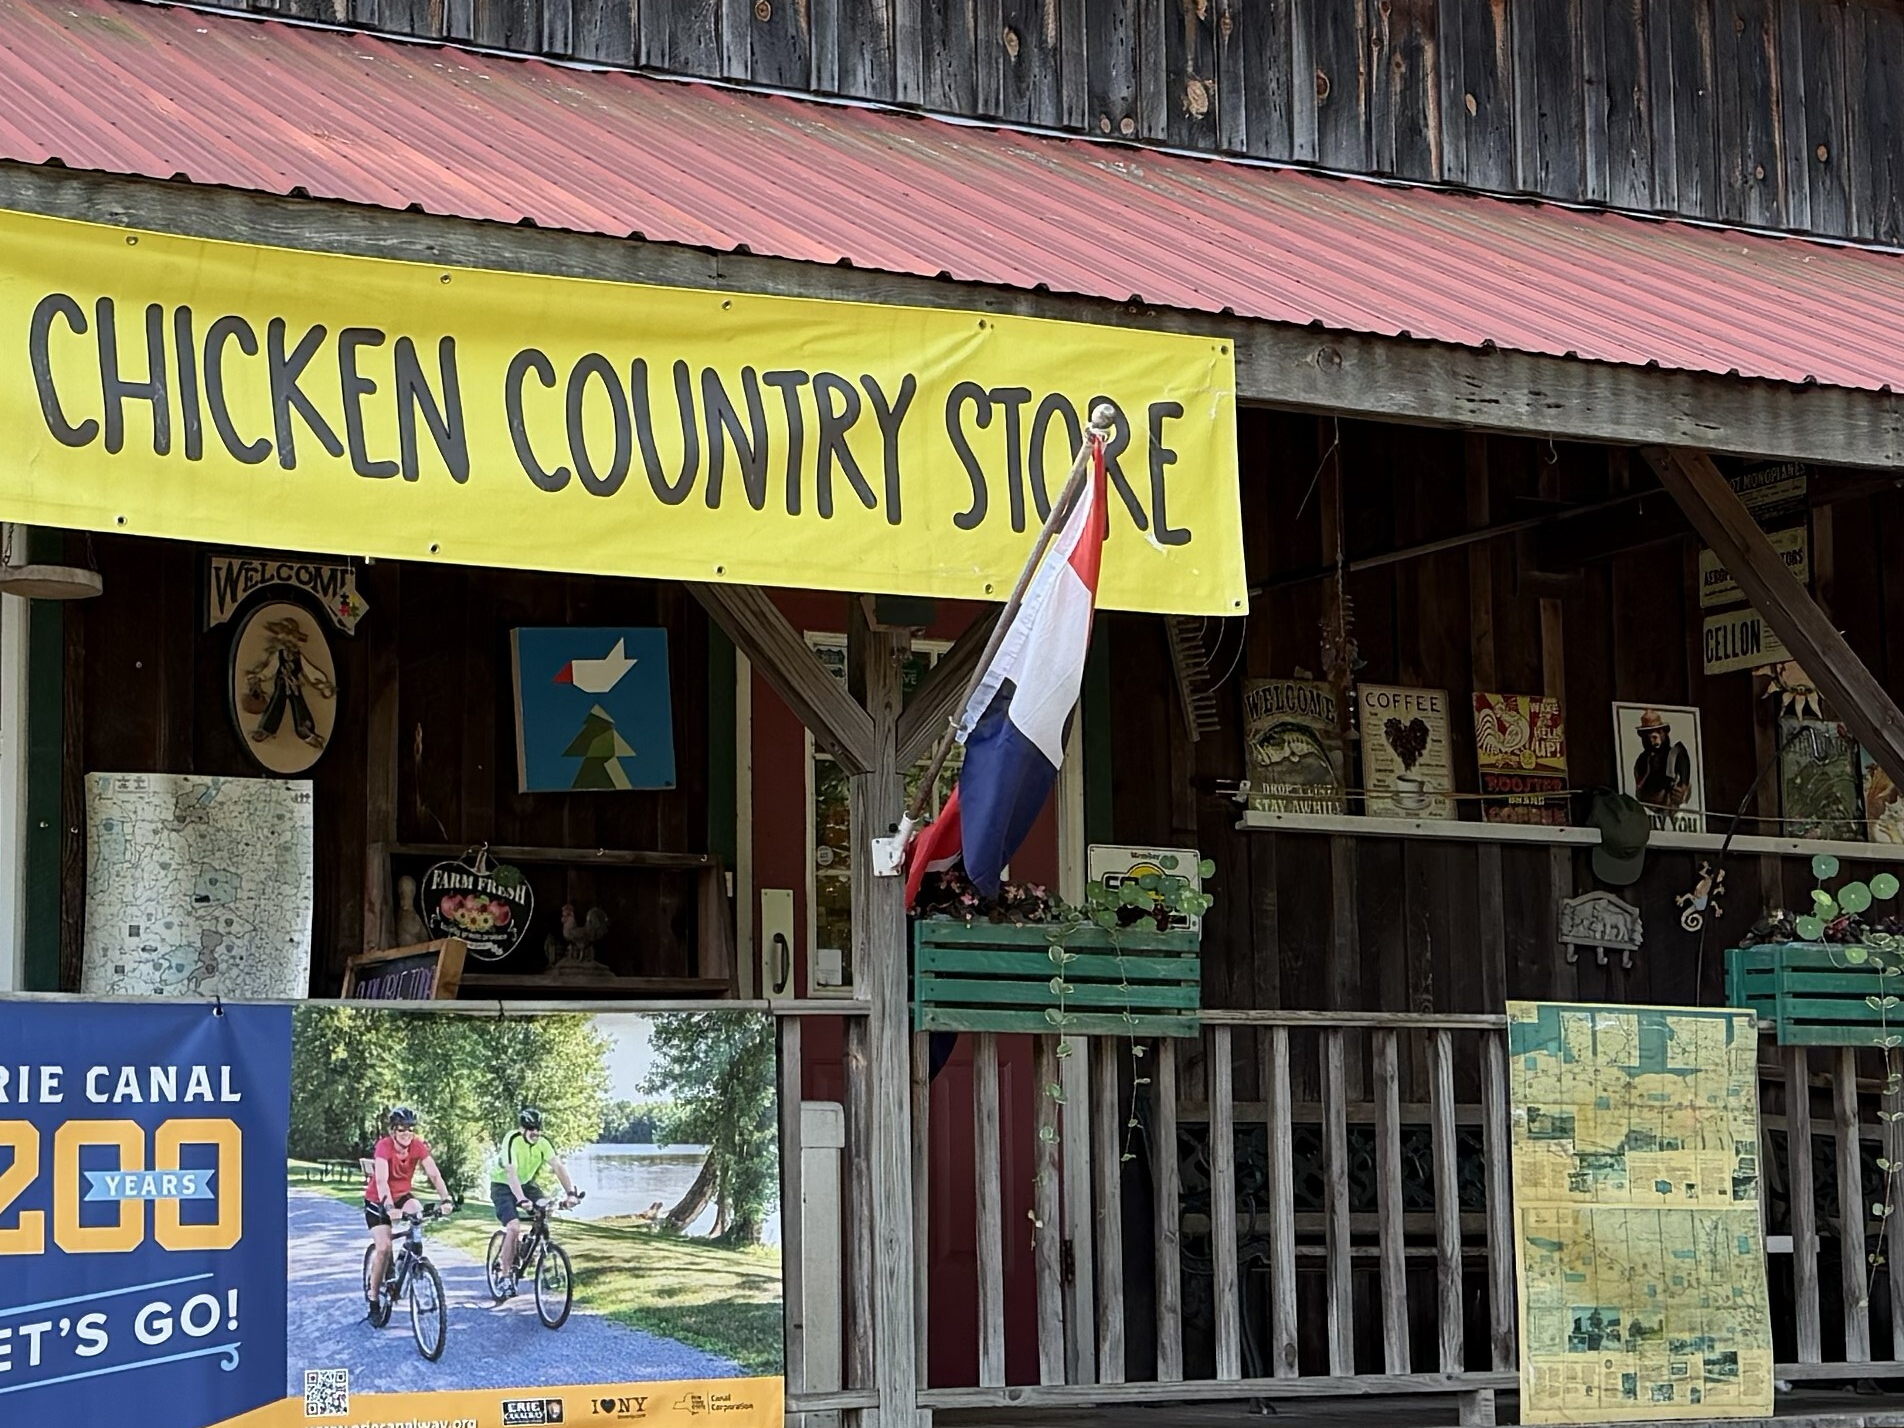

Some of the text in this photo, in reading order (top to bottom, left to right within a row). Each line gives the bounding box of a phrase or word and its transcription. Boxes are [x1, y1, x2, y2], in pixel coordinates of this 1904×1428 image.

[29, 293, 470, 484] CHICKEN
[504, 348, 916, 525] COUNTRY
[946, 380, 1192, 546] STORE
[1705, 619, 1761, 663] CELLON
[1245, 684, 1338, 724] WELCOME
[1365, 692, 1441, 713] COFFEE
[1535, 740, 1561, 758] UP!
[1254, 798, 1286, 813] STAY
[431, 870, 474, 890] FARM
[83, 1063, 243, 1104] CANAL
[103, 1171, 198, 1198] YEARS
[134, 1288, 240, 1348] GO!
[507, 1401, 541, 1413] ERIE
[617, 1396, 649, 1414] NY
[710, 1394, 732, 1403] Canal
[710, 1402, 754, 1413] Corporation
